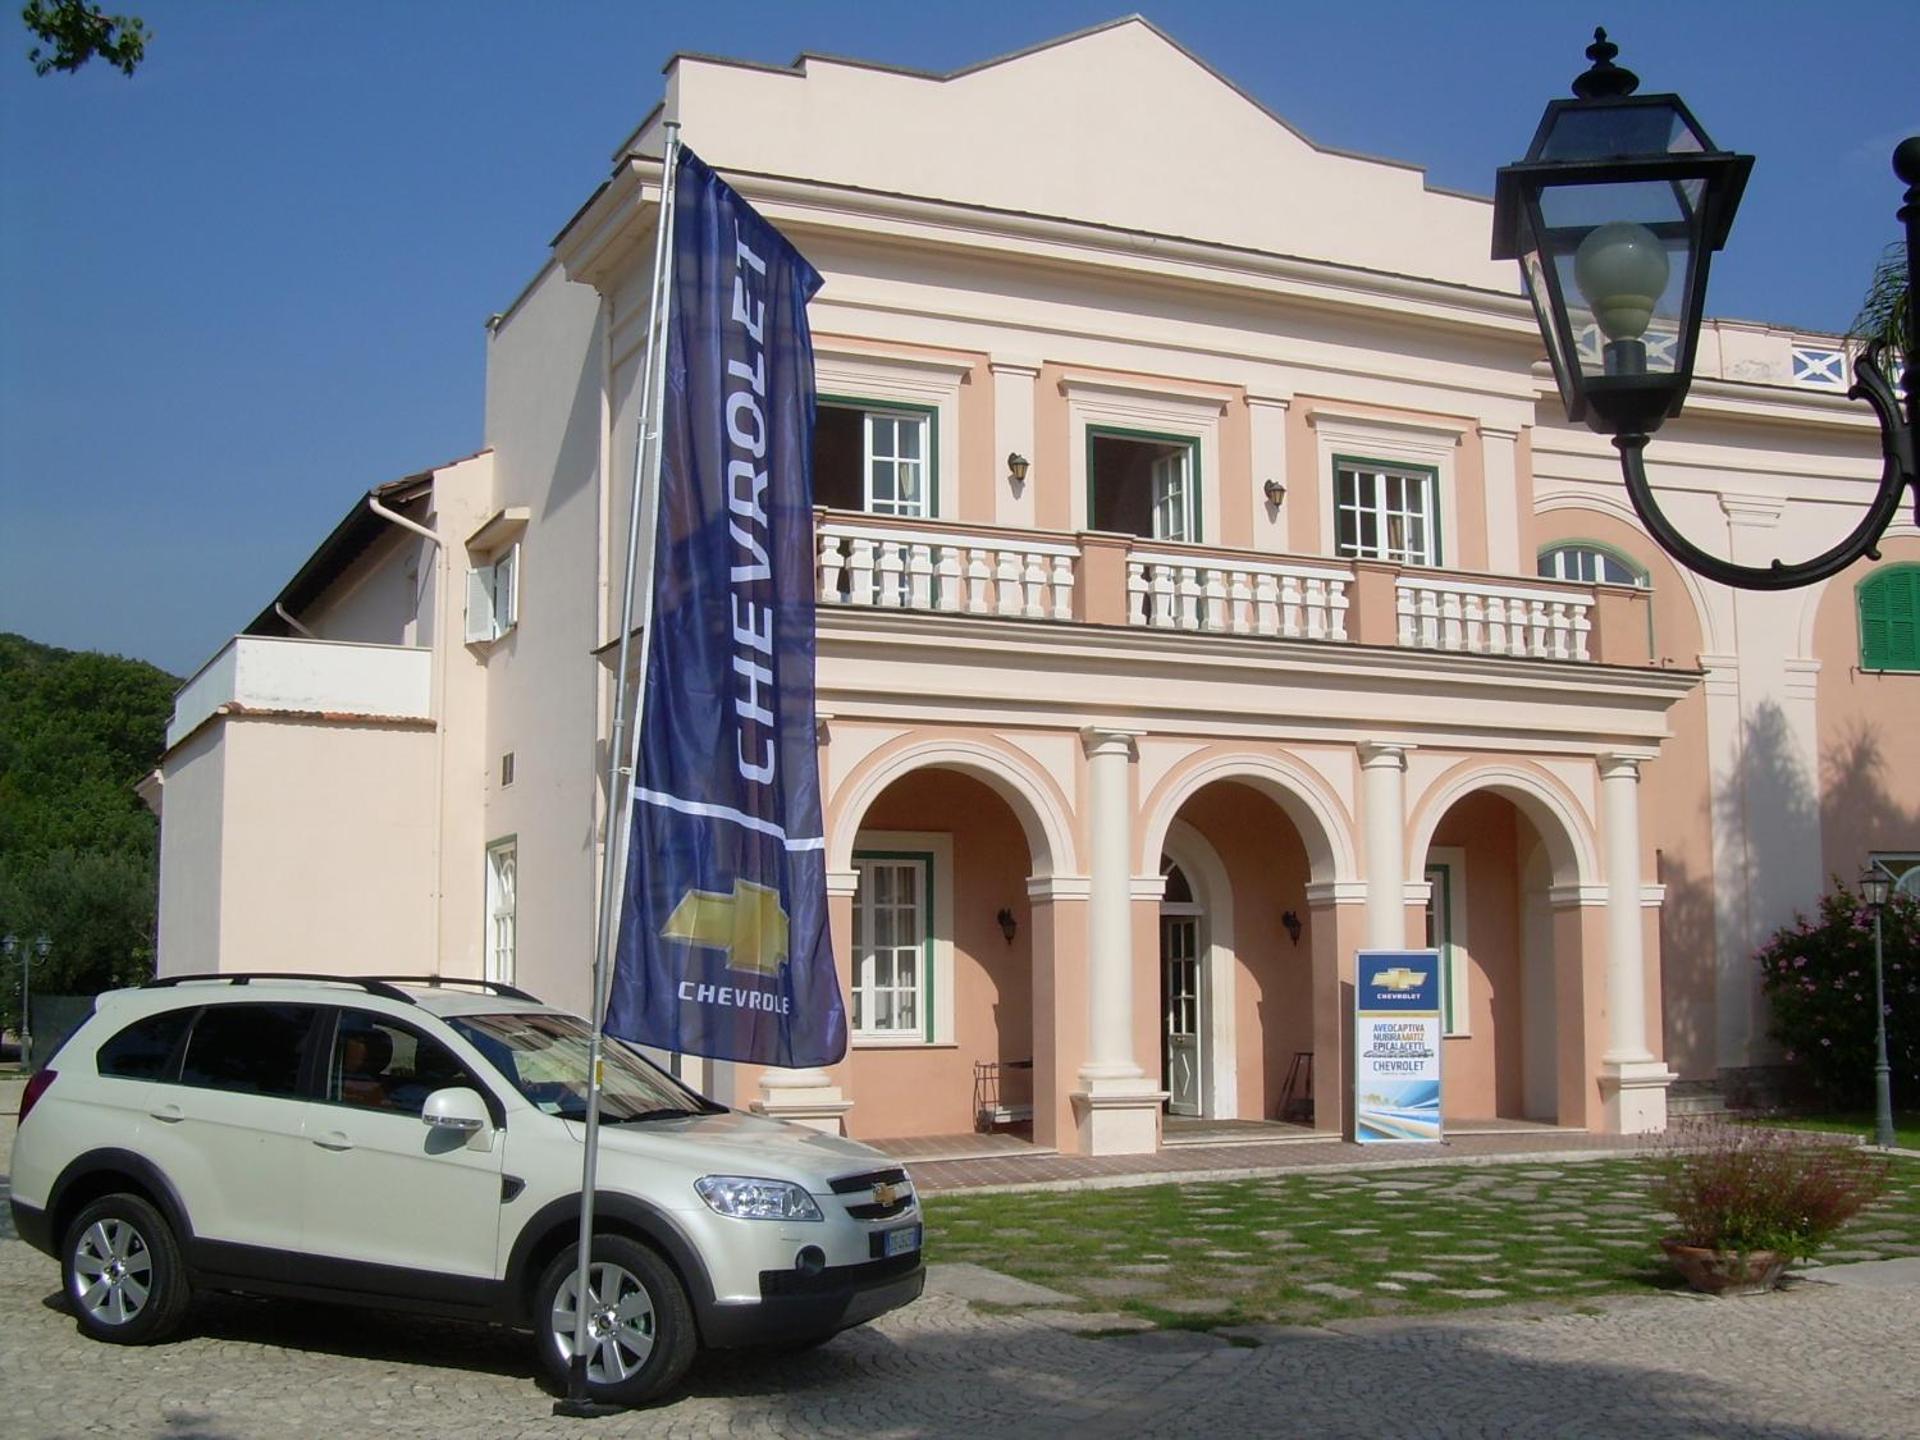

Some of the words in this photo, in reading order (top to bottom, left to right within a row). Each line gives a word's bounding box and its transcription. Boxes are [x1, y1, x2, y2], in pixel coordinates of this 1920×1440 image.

[726, 217, 774, 786] CHEVROLET
[678, 980, 790, 1015] CHEVROLE
[1373, 1060, 1425, 1071] CHEVROLET
